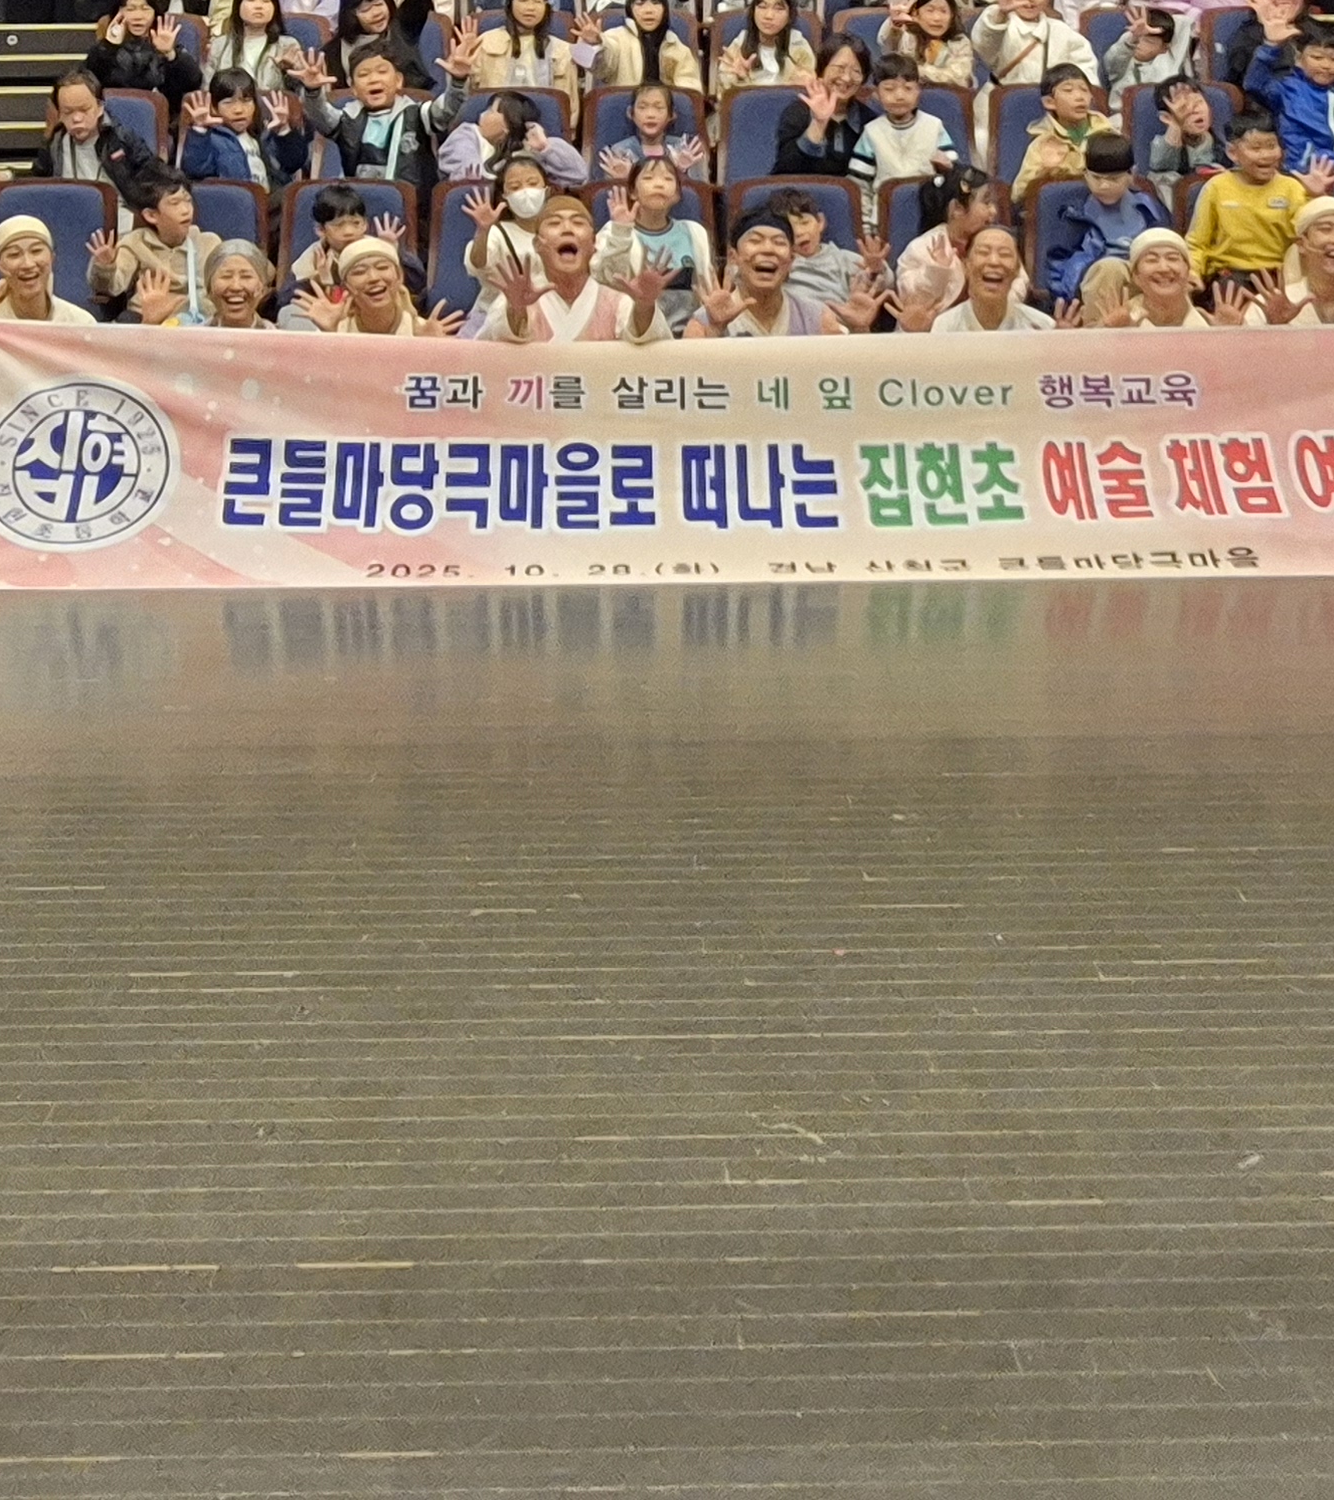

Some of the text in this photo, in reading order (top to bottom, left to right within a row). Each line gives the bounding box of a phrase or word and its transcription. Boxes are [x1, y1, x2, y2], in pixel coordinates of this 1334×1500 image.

[405, 373, 1197, 410] 꿈과 끼를 살리는 네 잎 Clover 행복교육
[222, 438, 656, 531] 큰들마당극마을로
[681, 442, 839, 530] 떠나는
[858, 441, 1025, 528] 집현초
[1041, 440, 1154, 520] 예술
[1167, 437, 1288, 516] 체험
